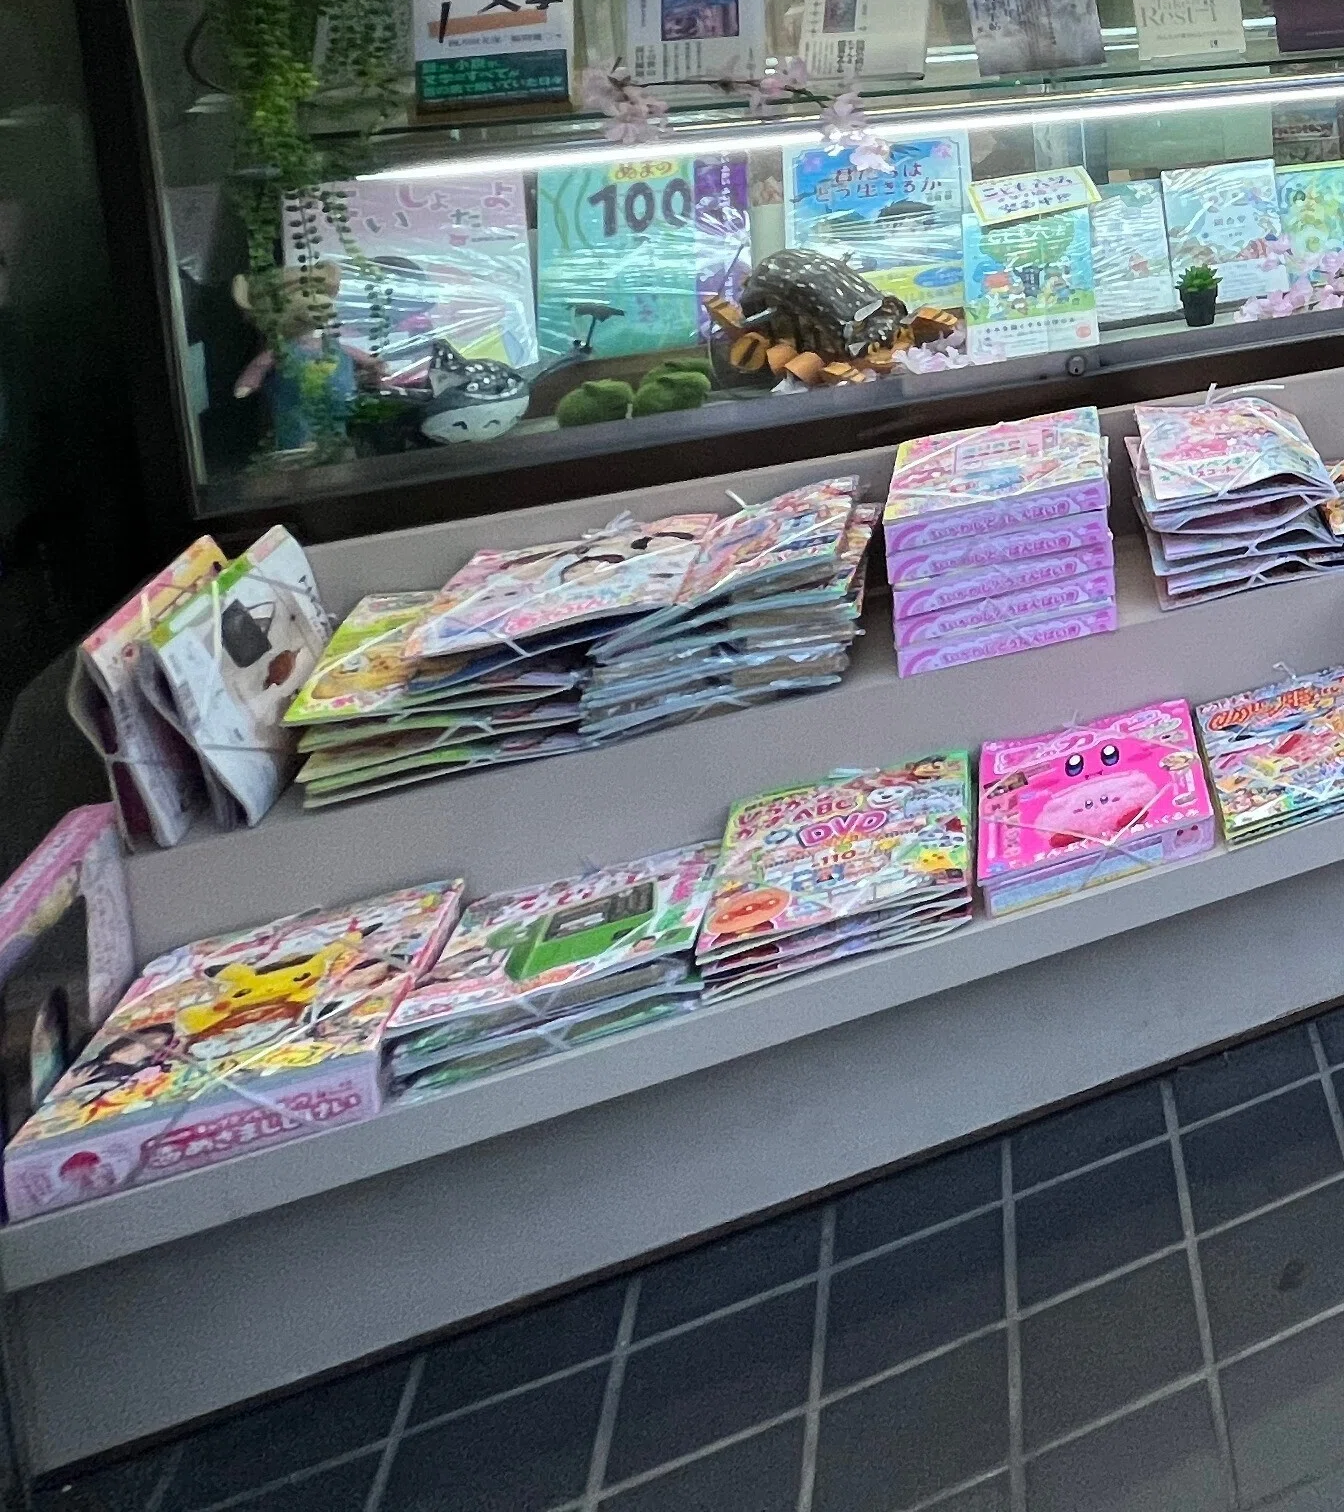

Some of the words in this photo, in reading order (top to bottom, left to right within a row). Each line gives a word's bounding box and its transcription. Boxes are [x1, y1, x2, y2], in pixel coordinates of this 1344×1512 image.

[615, 161, 672, 179] ぬまの
[587, 178, 692, 237] 100
[798, 809, 888, 849] DVD
